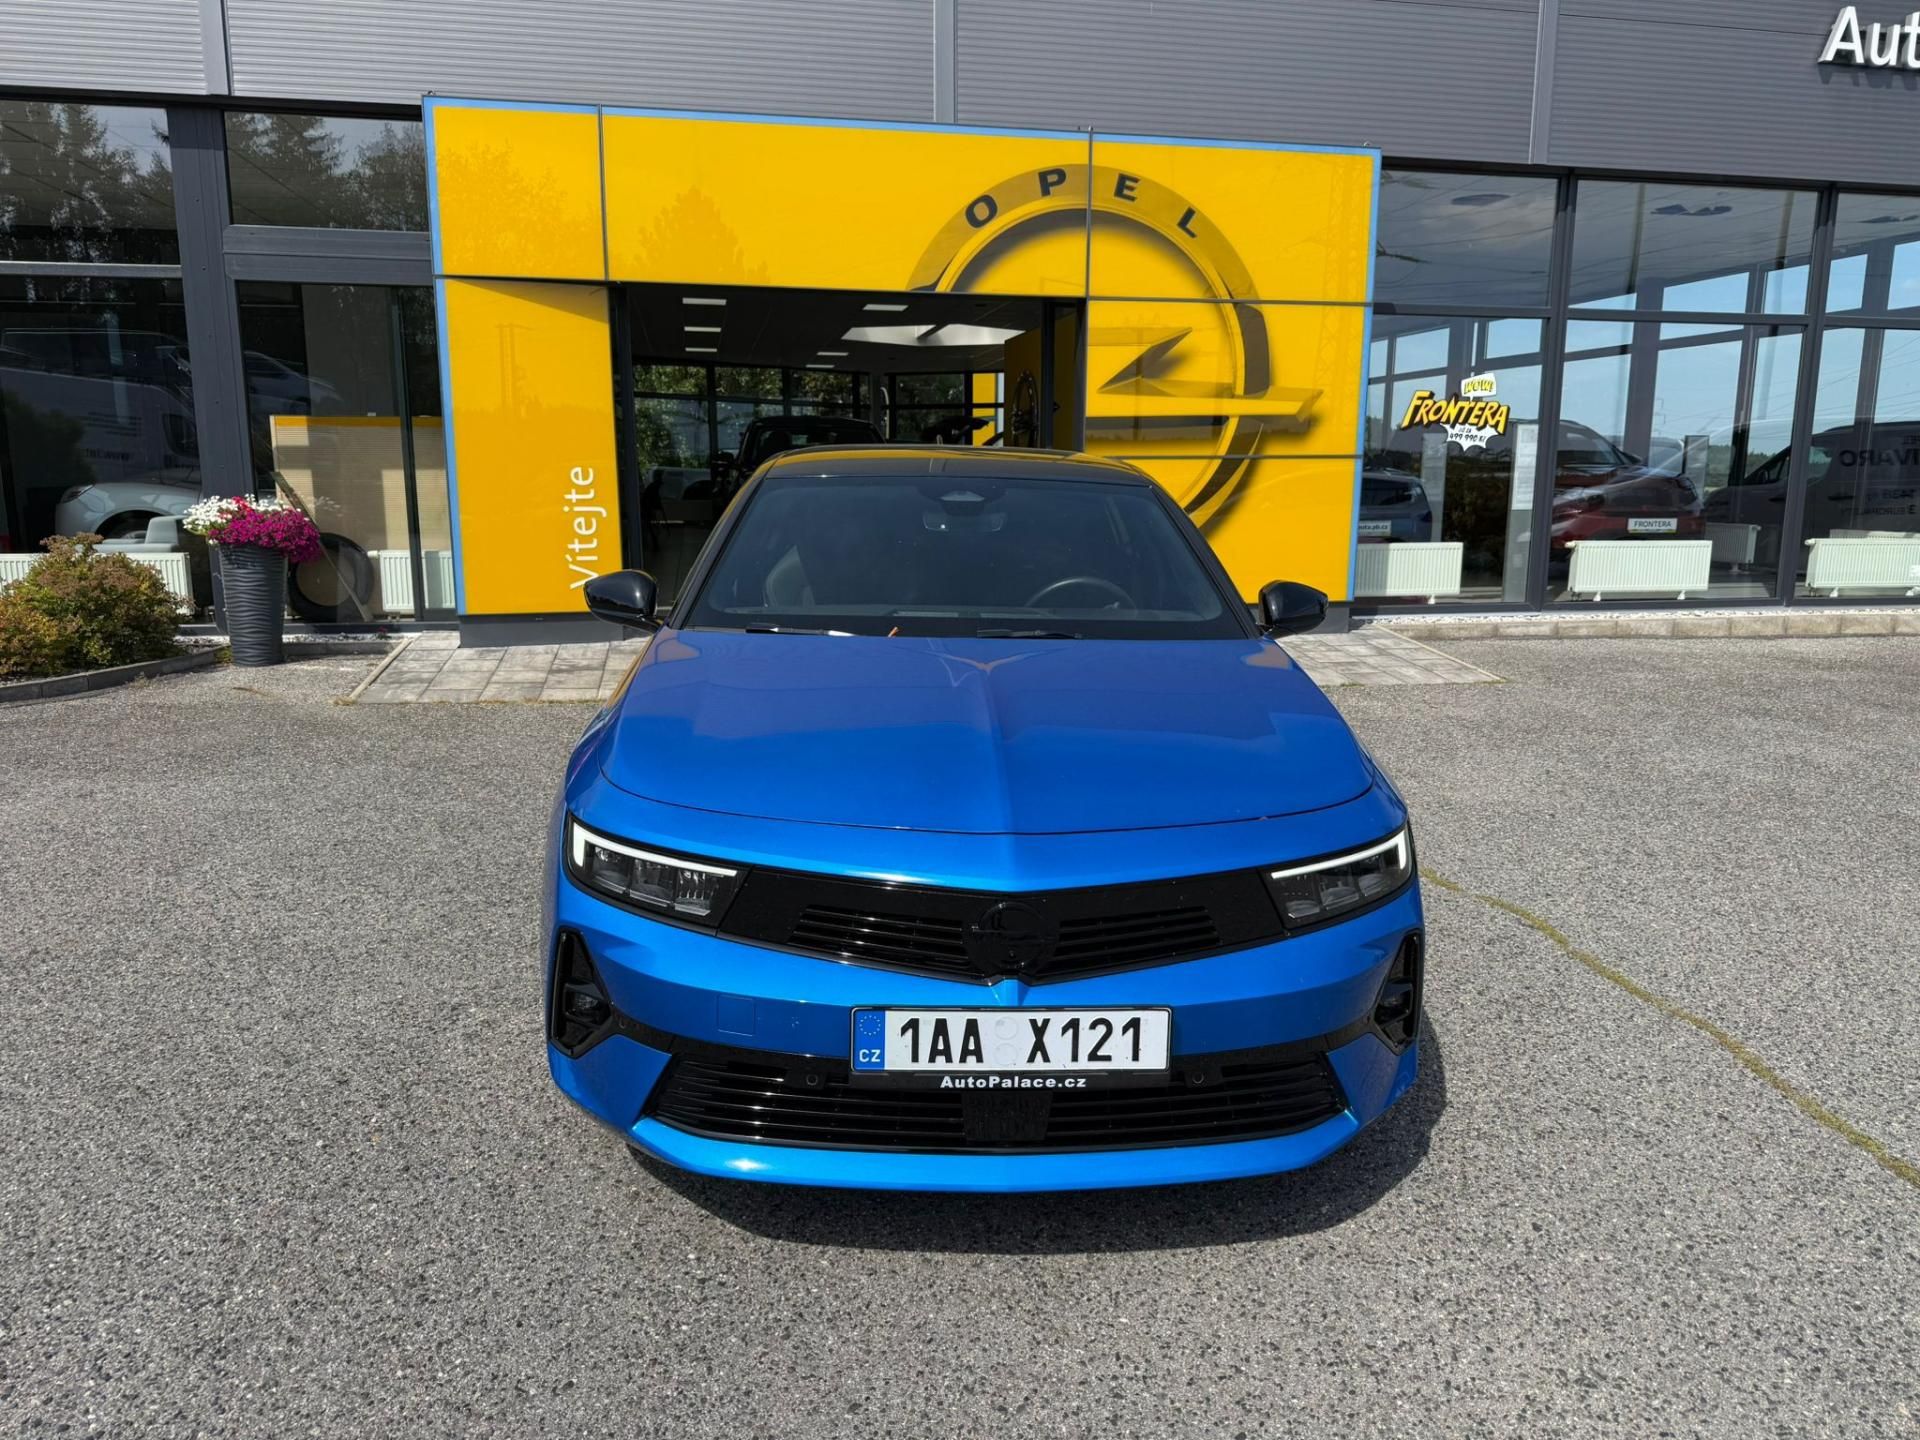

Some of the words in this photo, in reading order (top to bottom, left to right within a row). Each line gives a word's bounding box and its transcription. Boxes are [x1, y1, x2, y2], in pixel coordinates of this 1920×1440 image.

[965, 167, 1198, 239] OPEL
[1464, 379, 1494, 394] WOW!
[1401, 390, 1510, 435] FRONTERA
[1465, 434, 1478, 442] 990
[563, 467, 607, 589] Vítejte
[1633, 520, 1673, 528] FRONTERA
[900, 1017, 985, 1064] 1AA
[1026, 1016, 1142, 1063] X121
[858, 1049, 881, 1063] CZ
[940, 1075, 1087, 1088] AutoPalace.cz
